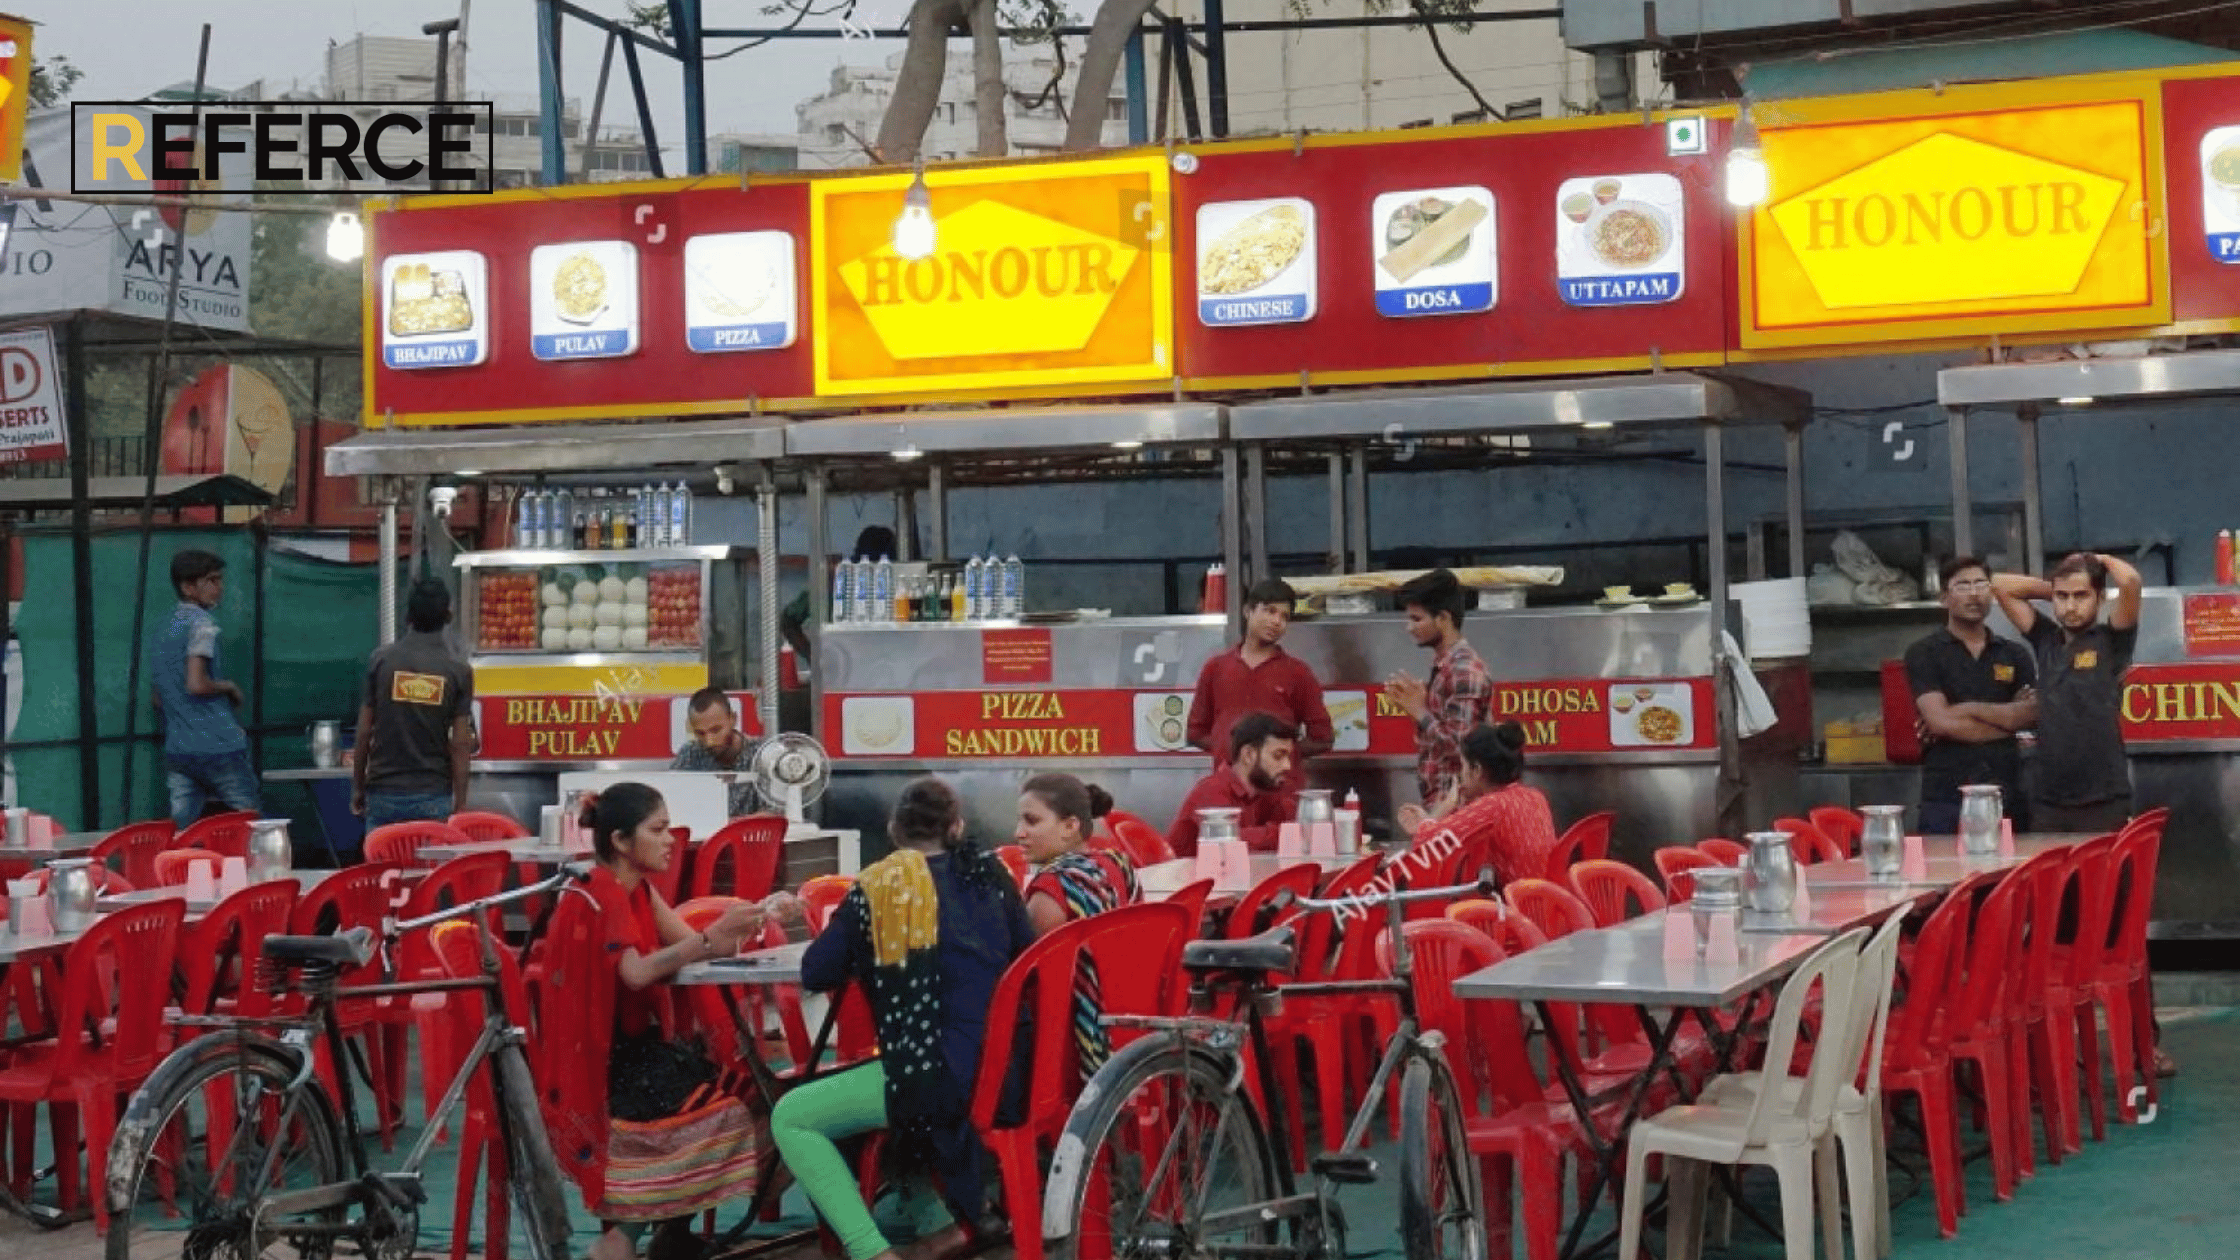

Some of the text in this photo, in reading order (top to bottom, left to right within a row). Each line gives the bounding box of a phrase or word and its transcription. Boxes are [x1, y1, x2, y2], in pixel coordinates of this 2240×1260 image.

[1805, 181, 2090, 251] HONOUR
[125, 238, 240, 289] ARYA
[862, 242, 1116, 306] HONOUR
[1405, 290, 1461, 310] DOSA
[1569, 277, 1669, 301] UTTAPAM
[178, 291, 240, 319] STUDIO
[1214, 299, 1293, 321] CHINESE
[554, 335, 608, 353] PULAV
[714, 329, 760, 346] PIZZA
[394, 345, 468, 364] BHAJIPAV
[507, 698, 642, 724] BHAJIPAV
[981, 693, 1064, 719] PIZZA
[1500, 688, 1601, 714] DHOSA
[2121, 681, 2240, 724] CHIN
[529, 730, 622, 755] PULAV
[946, 728, 1101, 755] SANDWICH
